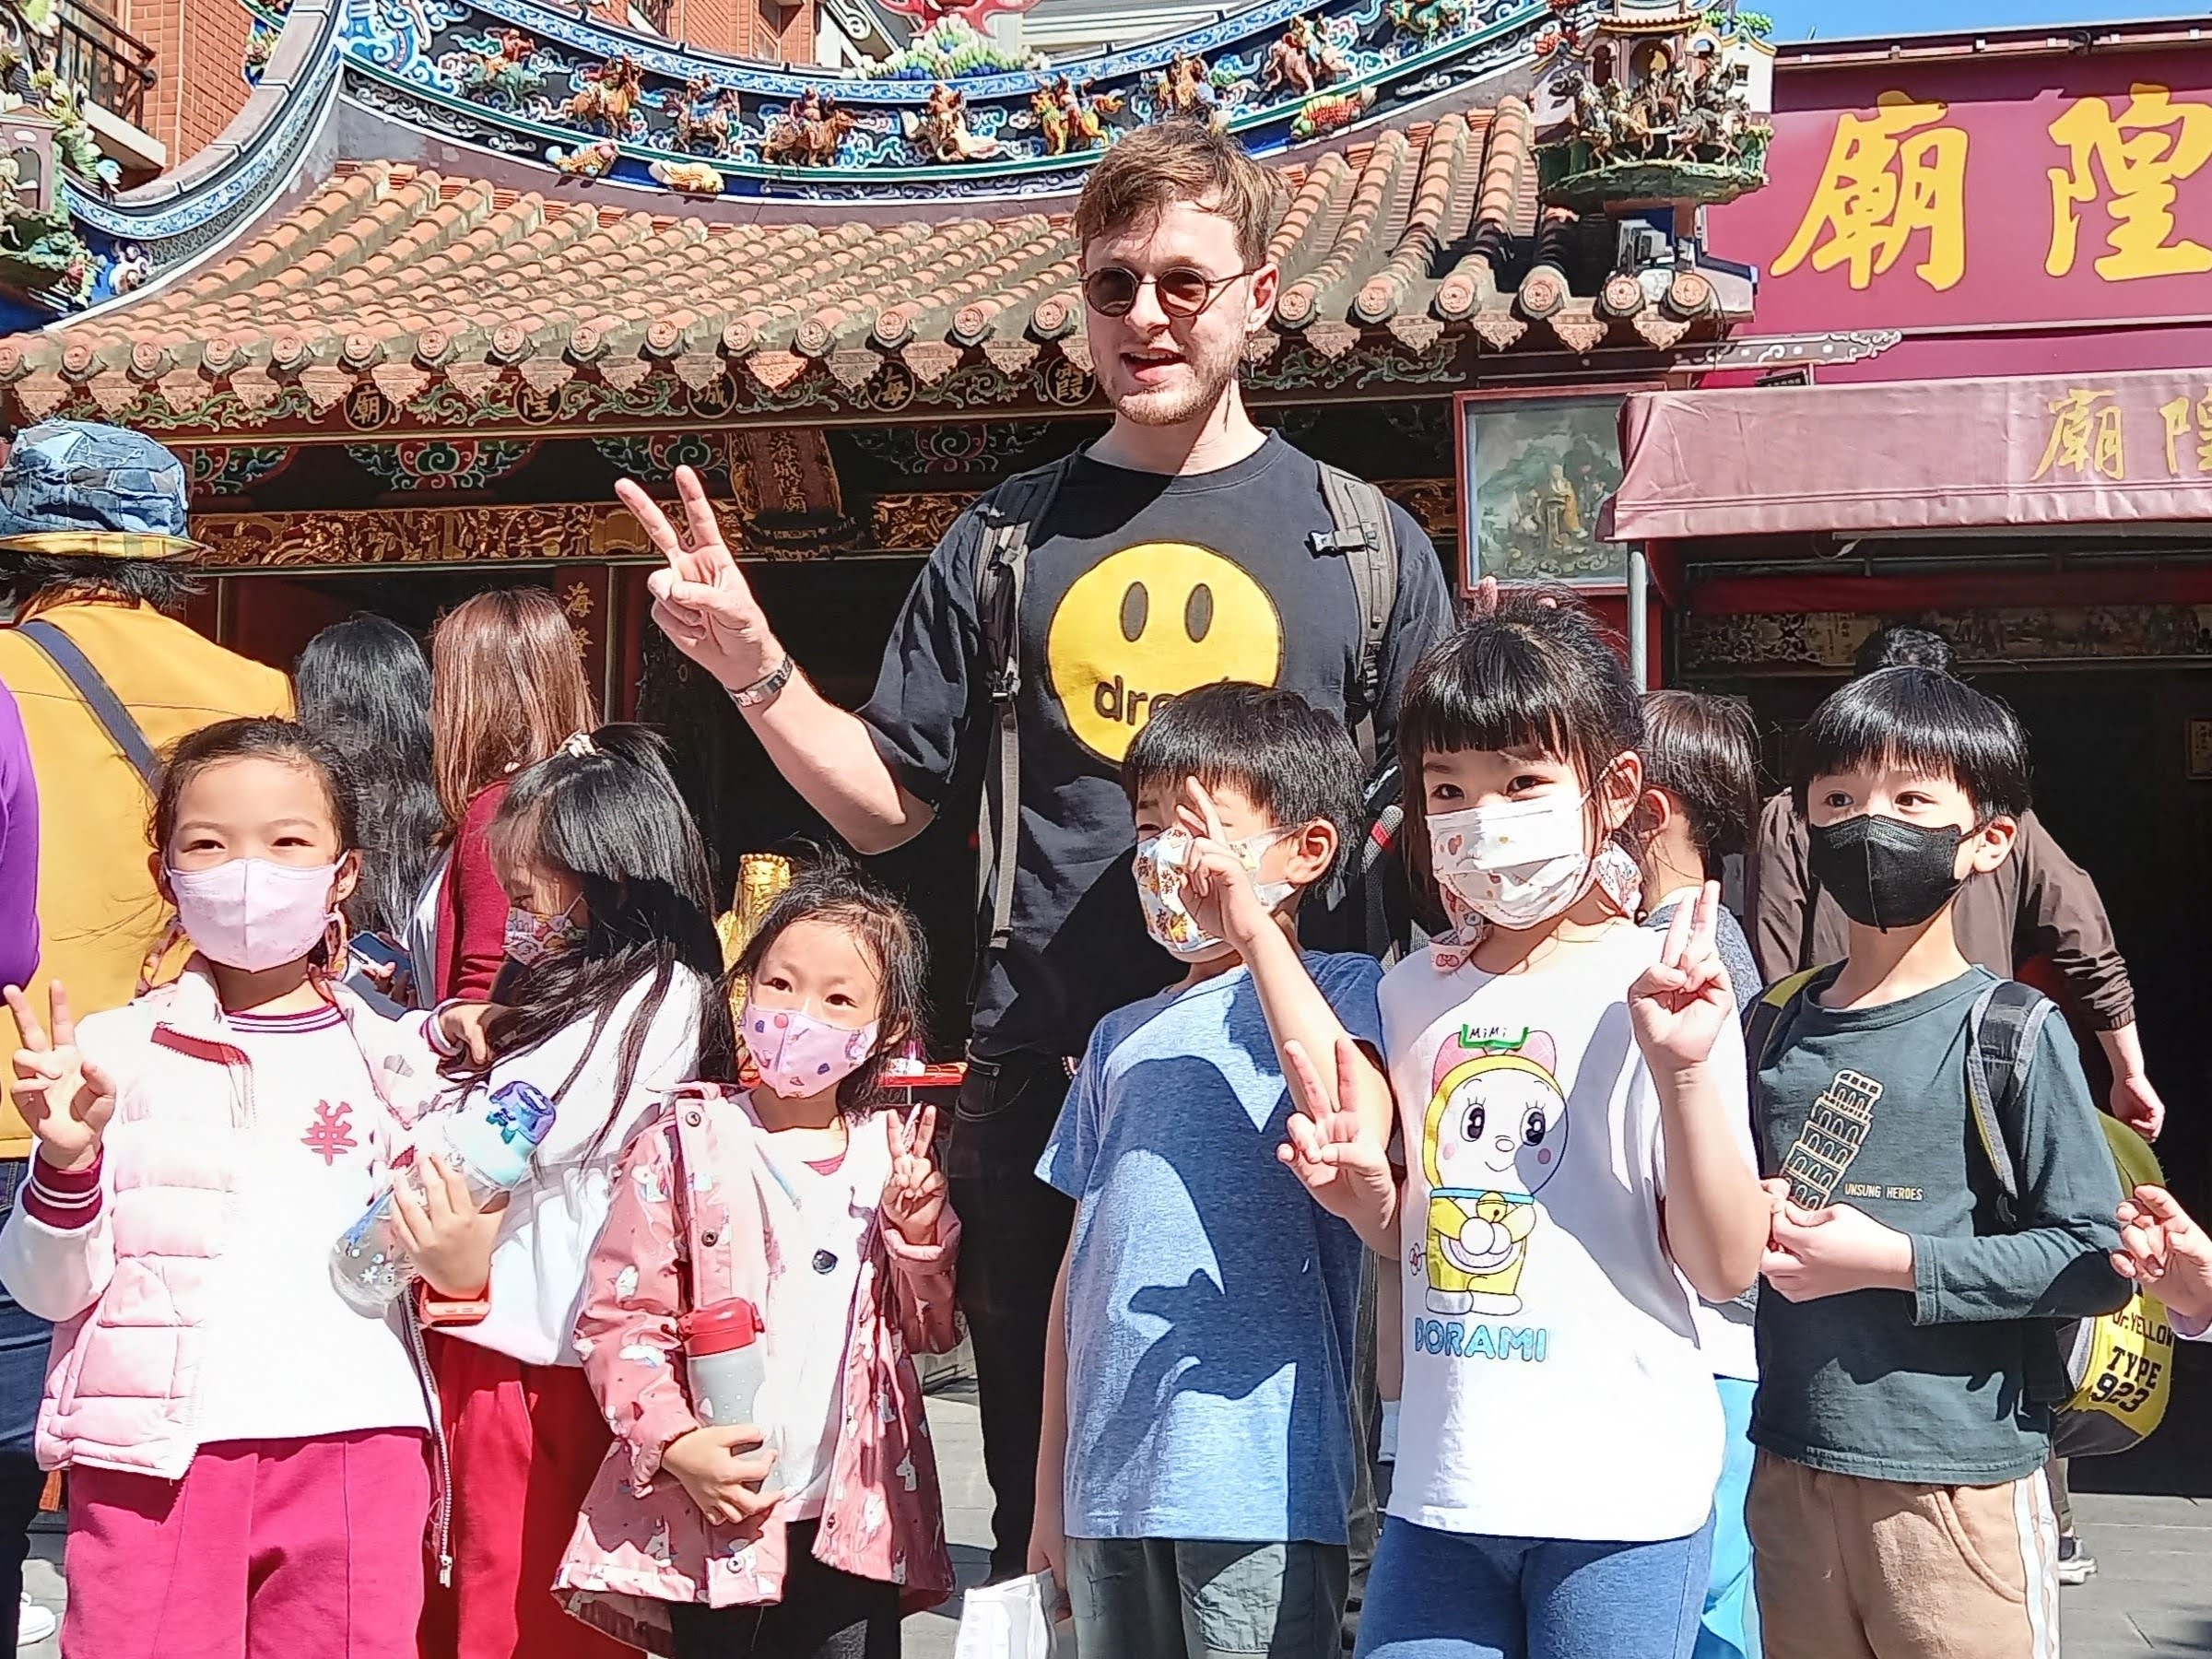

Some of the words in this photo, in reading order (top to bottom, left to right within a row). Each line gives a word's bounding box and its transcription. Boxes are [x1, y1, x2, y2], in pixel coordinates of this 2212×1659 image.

[350, 385, 380, 424] 廟
[877, 367, 910, 406] 海
[300, 1099, 358, 1166] 華
[1844, 1182, 1881, 1198] UNSUNG
[1886, 1186, 1924, 1201] HEROES
[1415, 1317, 1547, 1362] DORAMI
[2107, 1346, 2162, 1390] TYPE
[2090, 1372, 2150, 1413] 923
